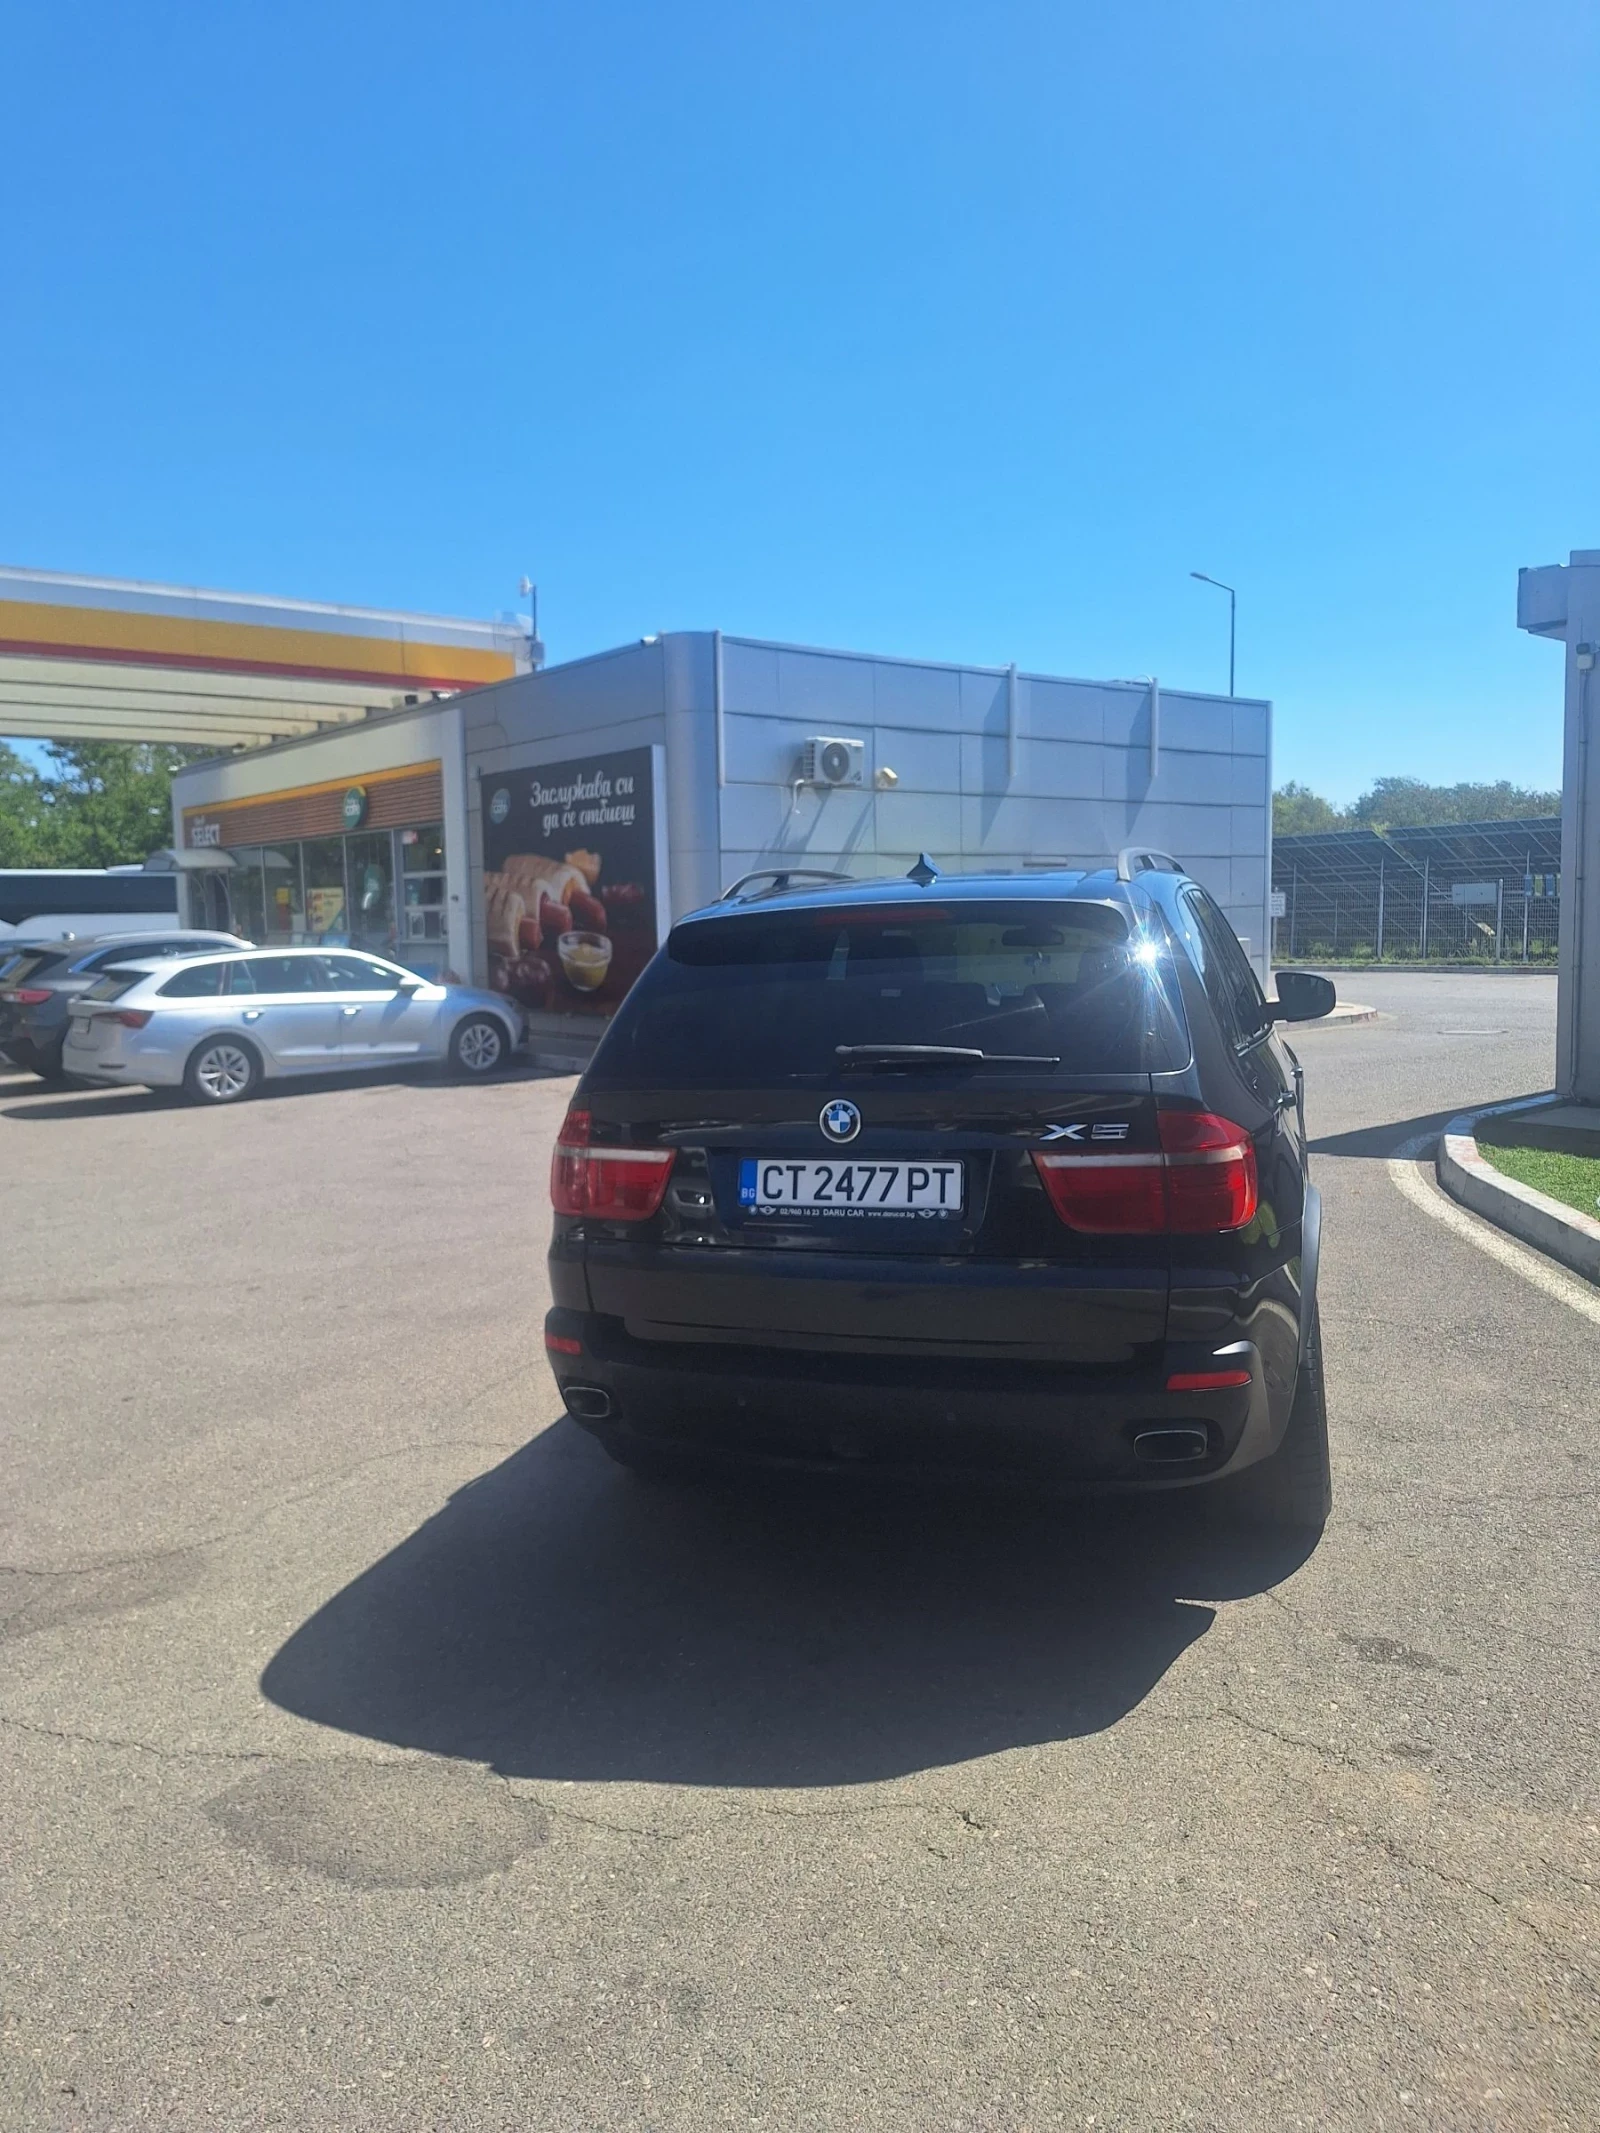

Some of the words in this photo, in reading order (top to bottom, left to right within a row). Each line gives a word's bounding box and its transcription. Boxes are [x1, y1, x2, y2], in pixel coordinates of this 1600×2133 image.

[530, 770, 611, 810] Заслужава
[616, 776, 634, 795] си
[543, 813, 559, 837] да
[562, 810, 577, 827] се
[579, 798, 635, 825] отбиеш
[826, 1103, 855, 1117] BMW
[1039, 1123, 1130, 1140] X5
[741, 1187, 756, 1199] BG
[762, 1165, 806, 1200] CT
[813, 1165, 899, 1202] 2477
[907, 1167, 955, 1204] PT
[823, 1208, 845, 1217] DARU
[847, 1208, 865, 1218] CAR
